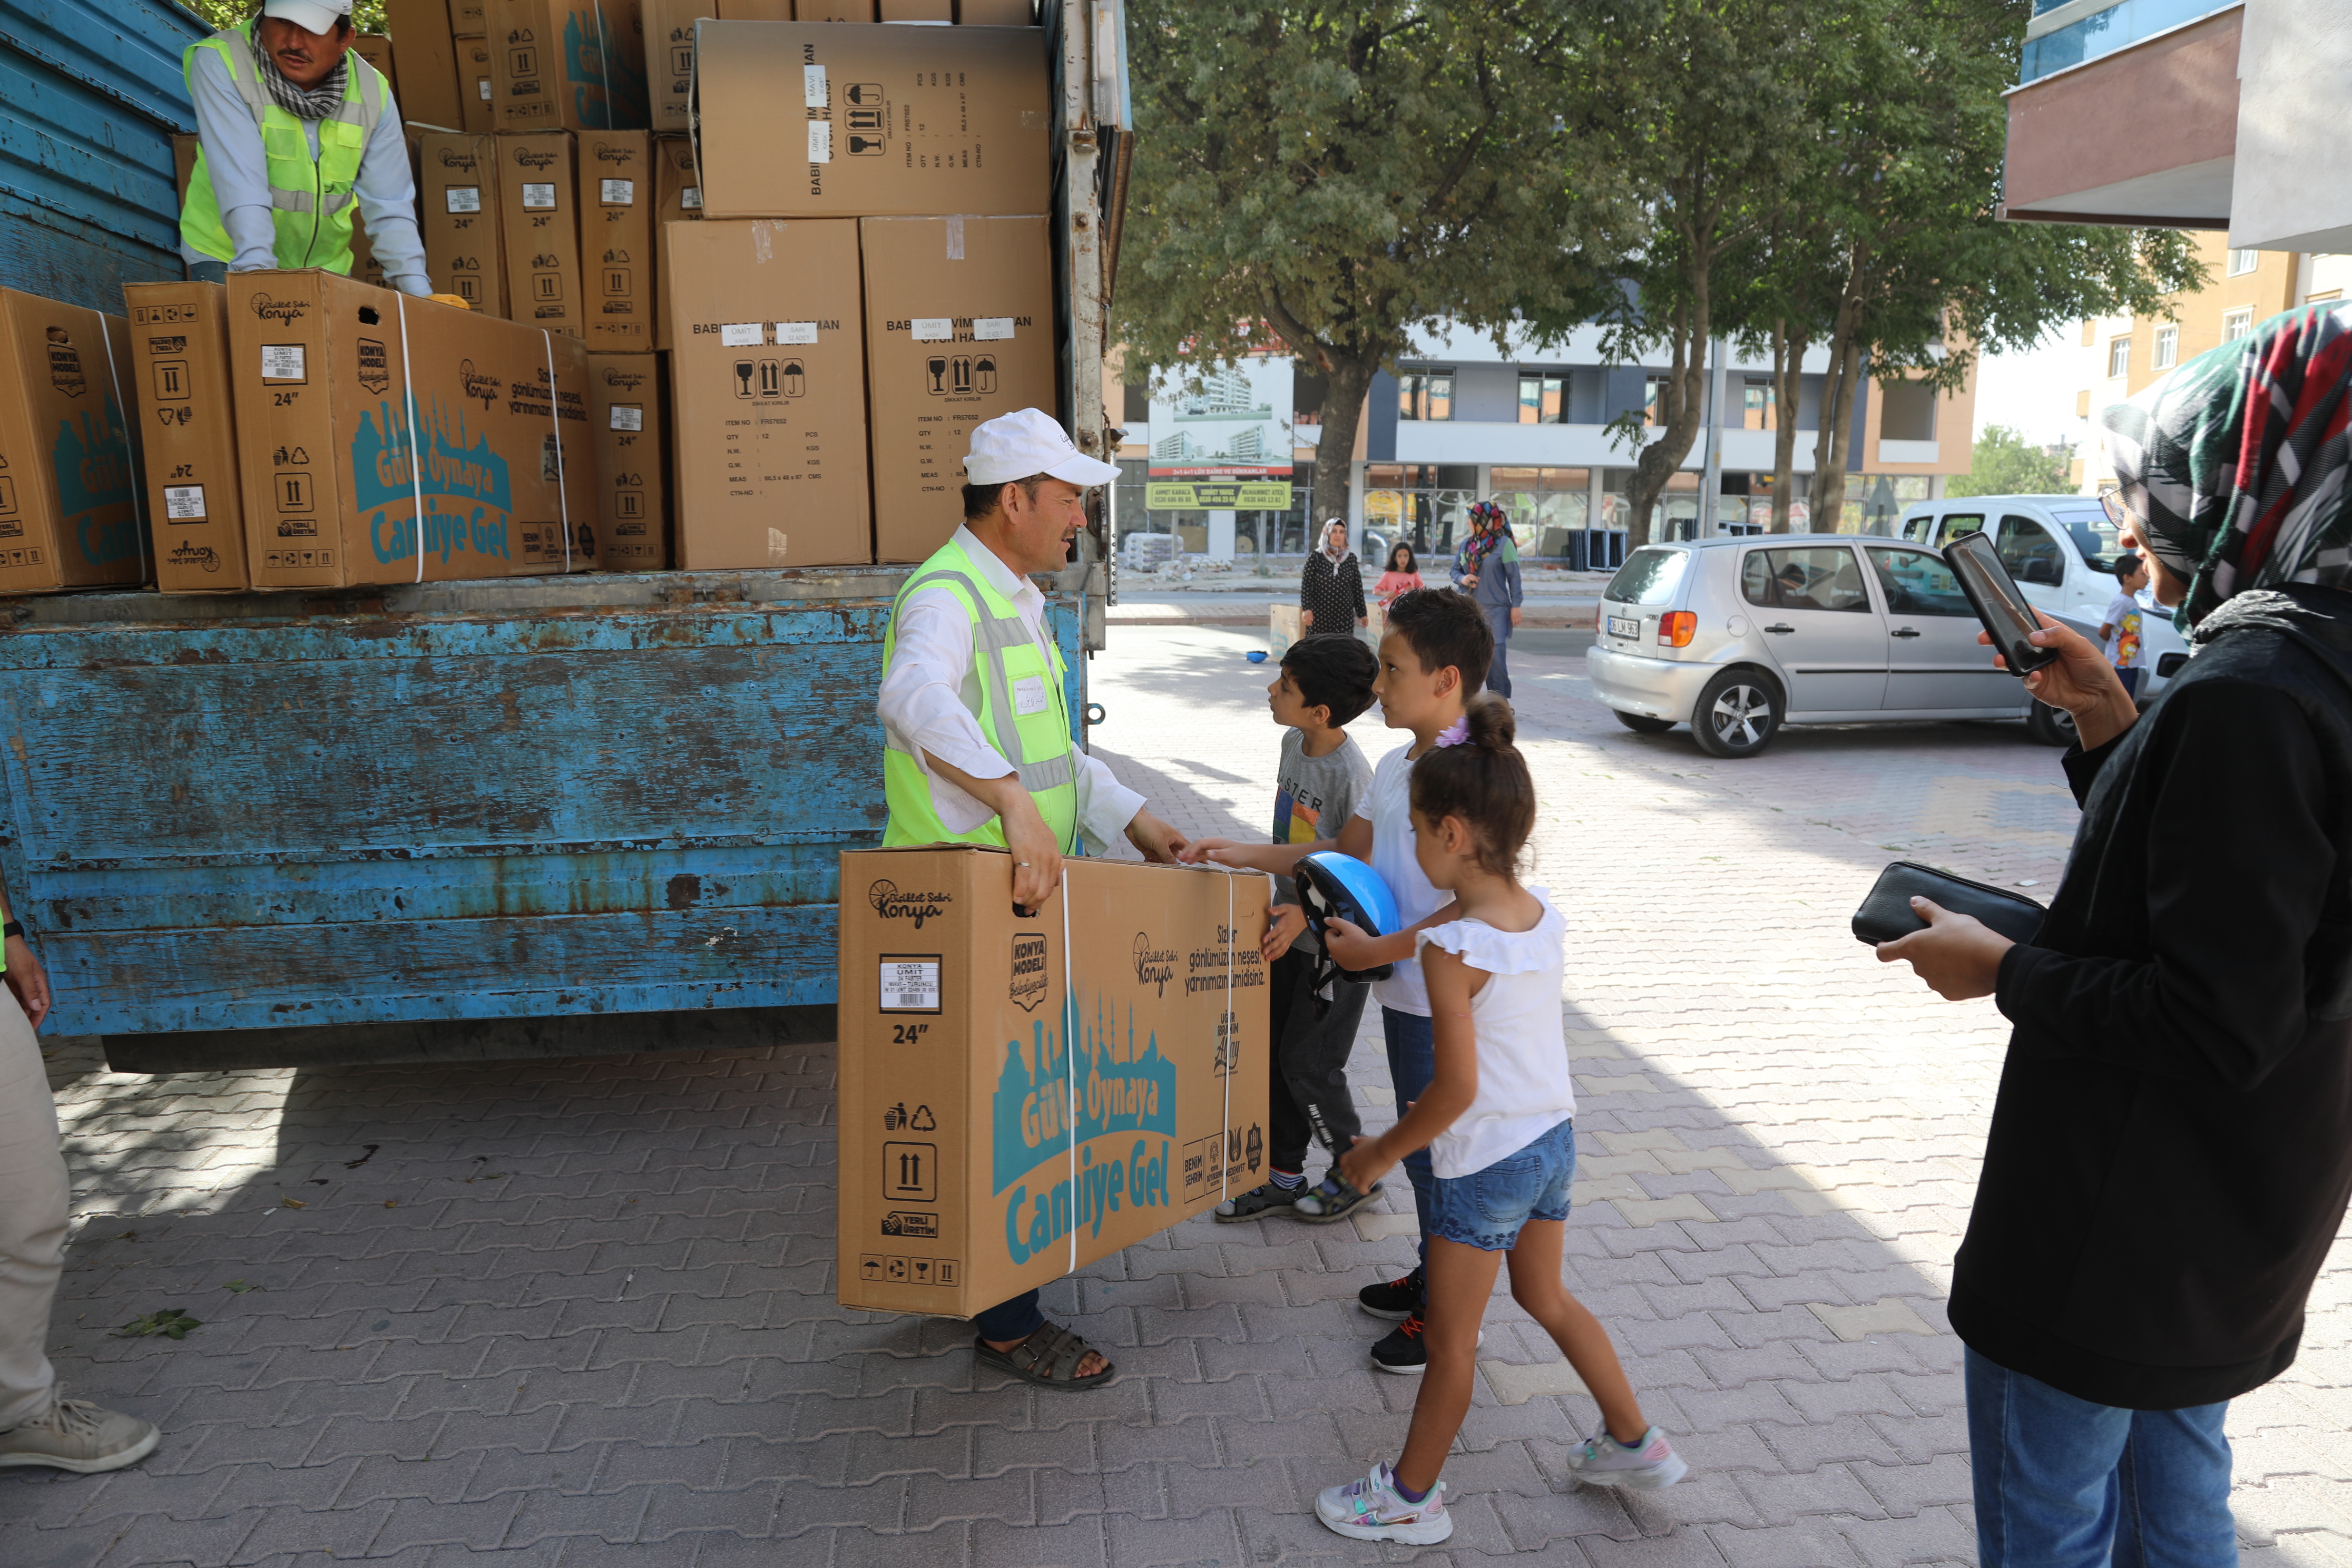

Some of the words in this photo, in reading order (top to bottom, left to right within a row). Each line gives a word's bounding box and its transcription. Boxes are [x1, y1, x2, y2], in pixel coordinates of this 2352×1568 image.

[906, 142, 912, 151] NO
[520, 157, 553, 171] Konya
[598, 152, 631, 166] Konya
[259, 305, 304, 327] Konya
[51, 351, 79, 362] KONYA
[359, 346, 384, 357] KONYA
[608, 375, 642, 391] Konya
[274, 392, 298, 406] 24"
[466, 378, 497, 411] Konya
[170, 464, 193, 478] 24"
[376, 445, 425, 488] Güle
[428, 445, 493, 497] Oynaya
[370, 497, 467, 565] Camiye
[471, 506, 511, 561] Gel
[172, 540, 212, 561] Konya
[1618, 620, 1626, 633] LM
[1628, 622, 1638, 635] 963
[878, 897, 944, 930] Konya
[1015, 940, 1044, 960] KONYA
[1145, 950, 1164, 964] Bisiklet
[1238, 947, 1261, 968] neşesi,
[1014, 956, 1044, 976] MODELİ
[1139, 956, 1173, 998] Konya
[1185, 974, 1228, 997] yarınımızın
[893, 1024, 929, 1044] 24"
[1021, 1077, 1082, 1148] Güle
[1087, 1069, 1159, 1132] Oynaya
[1185, 1154, 1202, 1173] BENİM
[1185, 1170, 1203, 1189] ŞEHRİM
[1230, 1174, 1241, 1184] OKULU
[1006, 1145, 1124, 1265] Camiye
[1129, 1139, 1169, 1207] Gel
[903, 1224, 935, 1234] ÜRETİM
[904, 1216, 928, 1225] YERLİ
